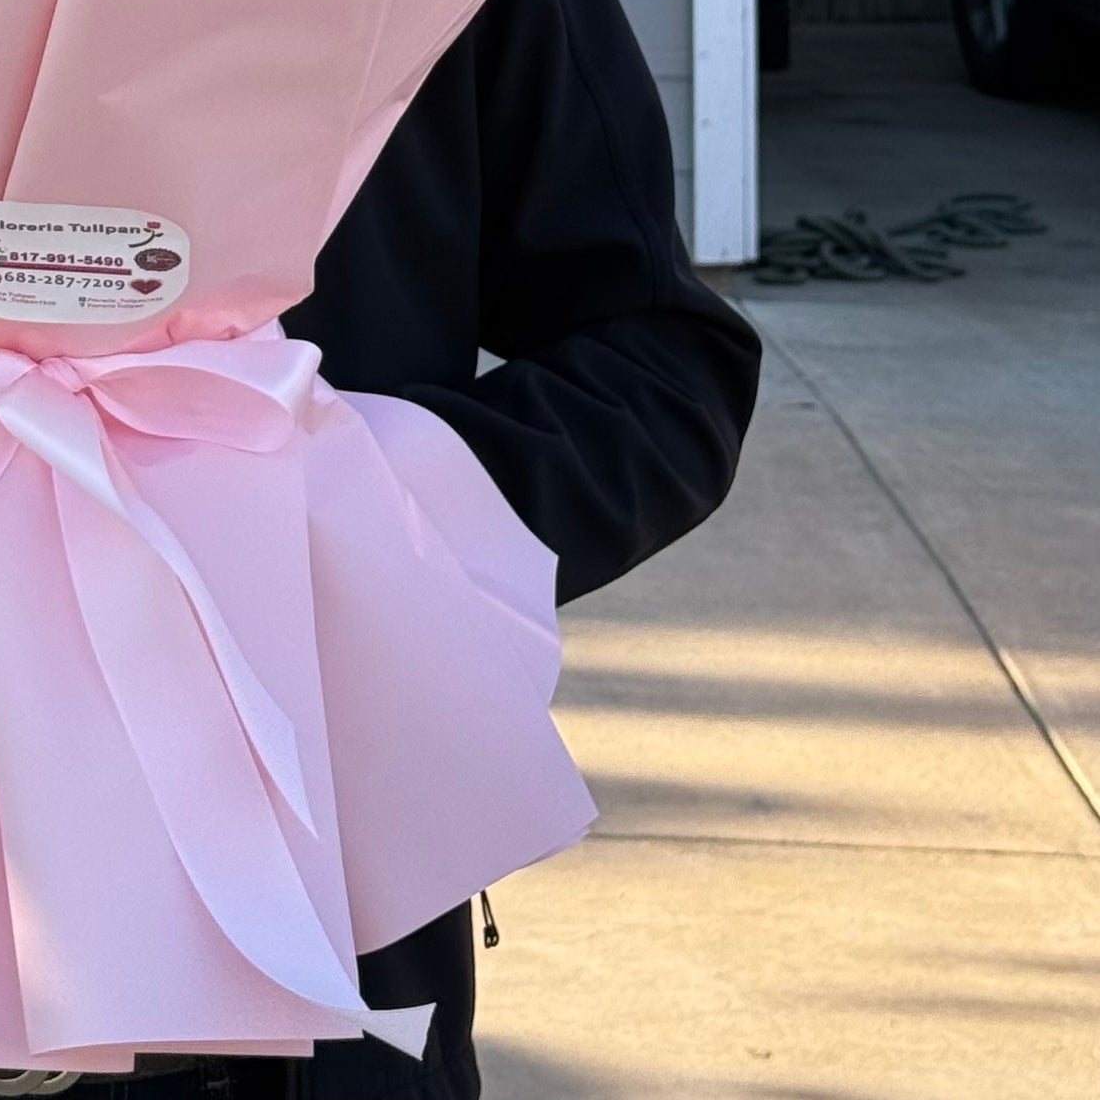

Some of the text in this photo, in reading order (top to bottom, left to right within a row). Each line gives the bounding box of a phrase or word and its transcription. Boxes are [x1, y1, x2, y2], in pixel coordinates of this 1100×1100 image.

[68, 223, 141, 235] Tulipan
[10, 251, 123, 267] 817-991-5490
[4, 271, 125, 290] 682-287-7209
